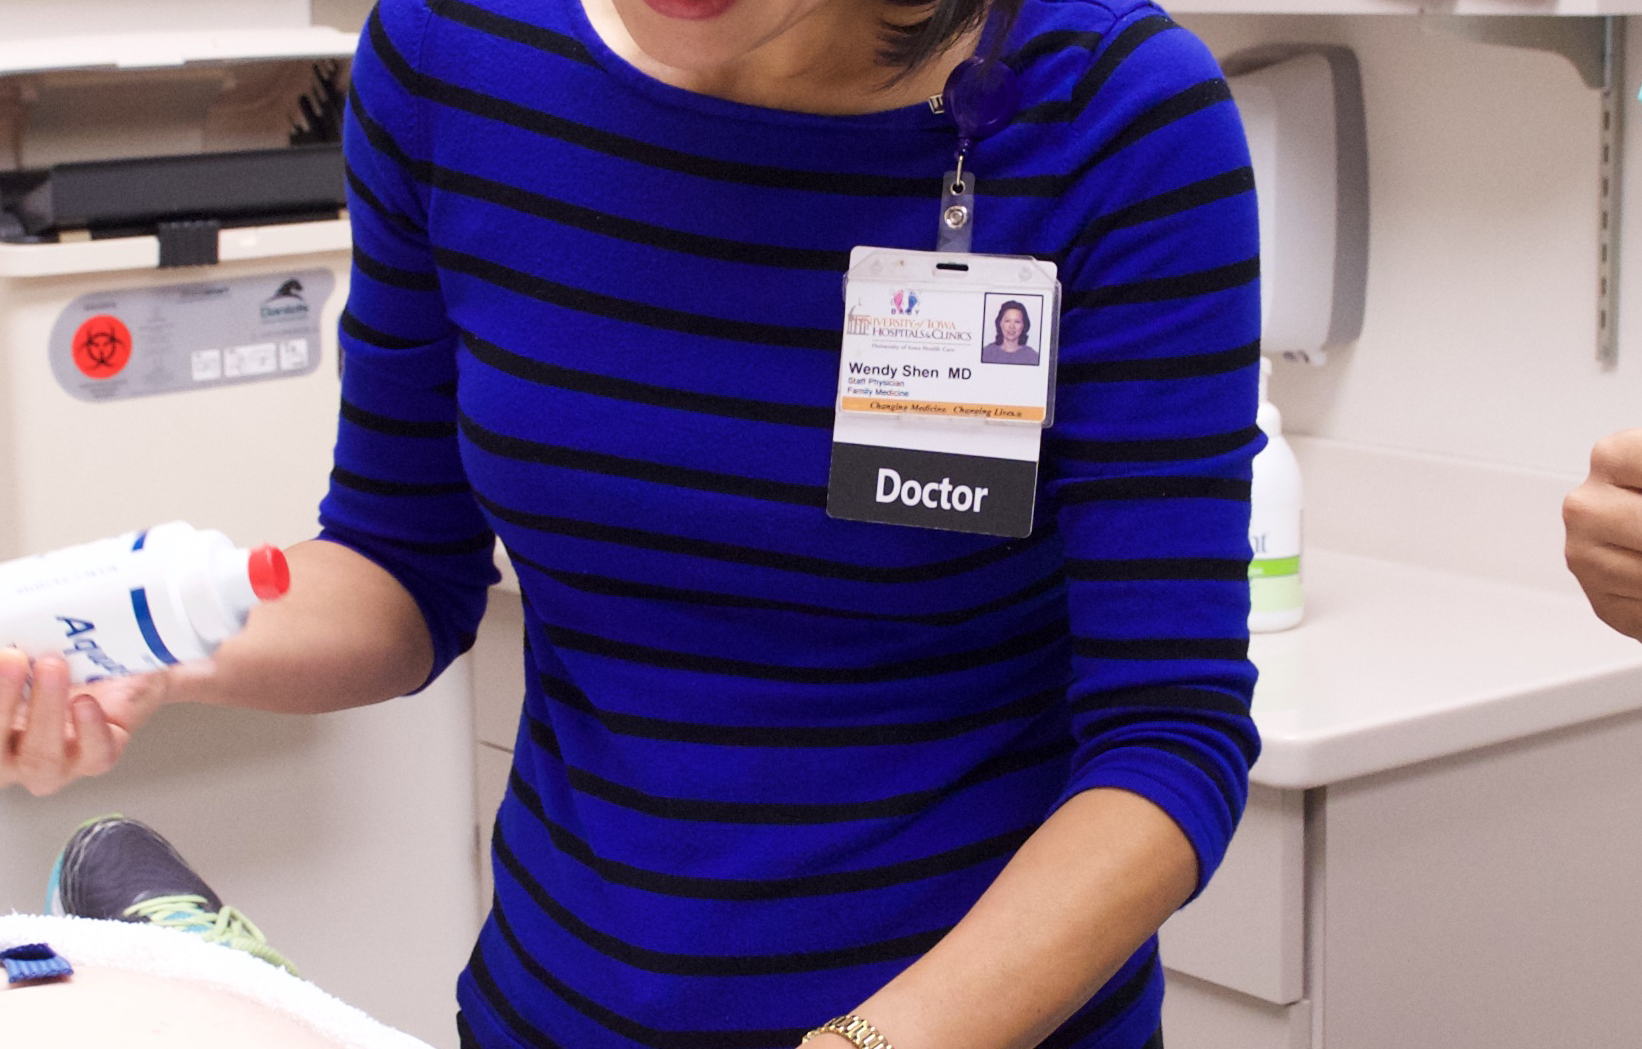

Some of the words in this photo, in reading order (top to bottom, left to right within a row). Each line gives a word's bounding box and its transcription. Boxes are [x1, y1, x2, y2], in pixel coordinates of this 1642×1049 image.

[849, 362, 897, 379] Wendy
[902, 365, 939, 379] Shen
[949, 367, 971, 380] MD
[848, 377, 866, 385] Staff
[868, 378, 905, 388] Physician
[847, 387, 872, 396] Family
[875, 388, 909, 397] Medicine
[870, 401, 908, 412] Changing
[953, 406, 991, 417] Changing
[876, 468, 988, 513] Doctor
